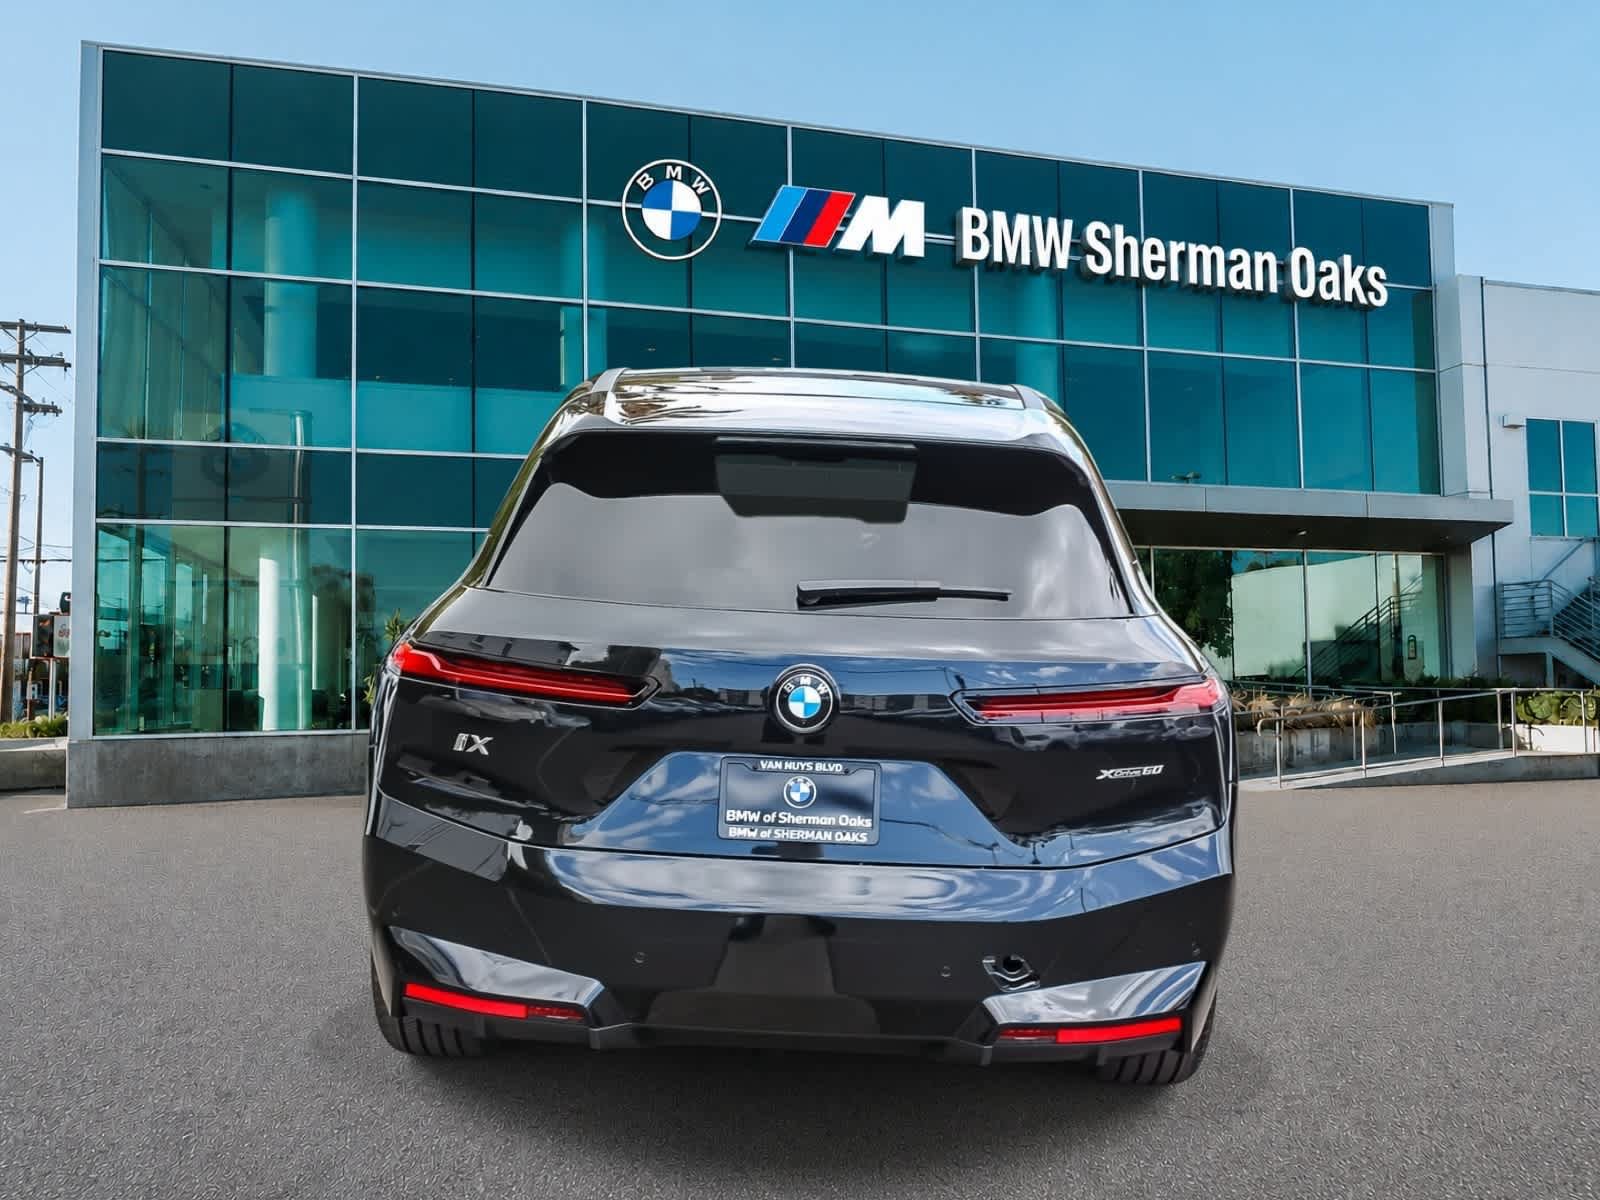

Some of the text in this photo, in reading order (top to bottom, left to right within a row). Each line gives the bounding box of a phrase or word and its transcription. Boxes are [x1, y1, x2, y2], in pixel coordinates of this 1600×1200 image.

[636, 165, 712, 195] BMW
[960, 206, 1389, 308] BMW Sherman Oaks
[783, 675, 829, 695] BMW
[760, 760, 843, 772] VAN NUYS BLVD
[726, 809, 873, 828] BMW of Sherman Oaks
[728, 826, 868, 842] BMW of SHERMAN OAKS
